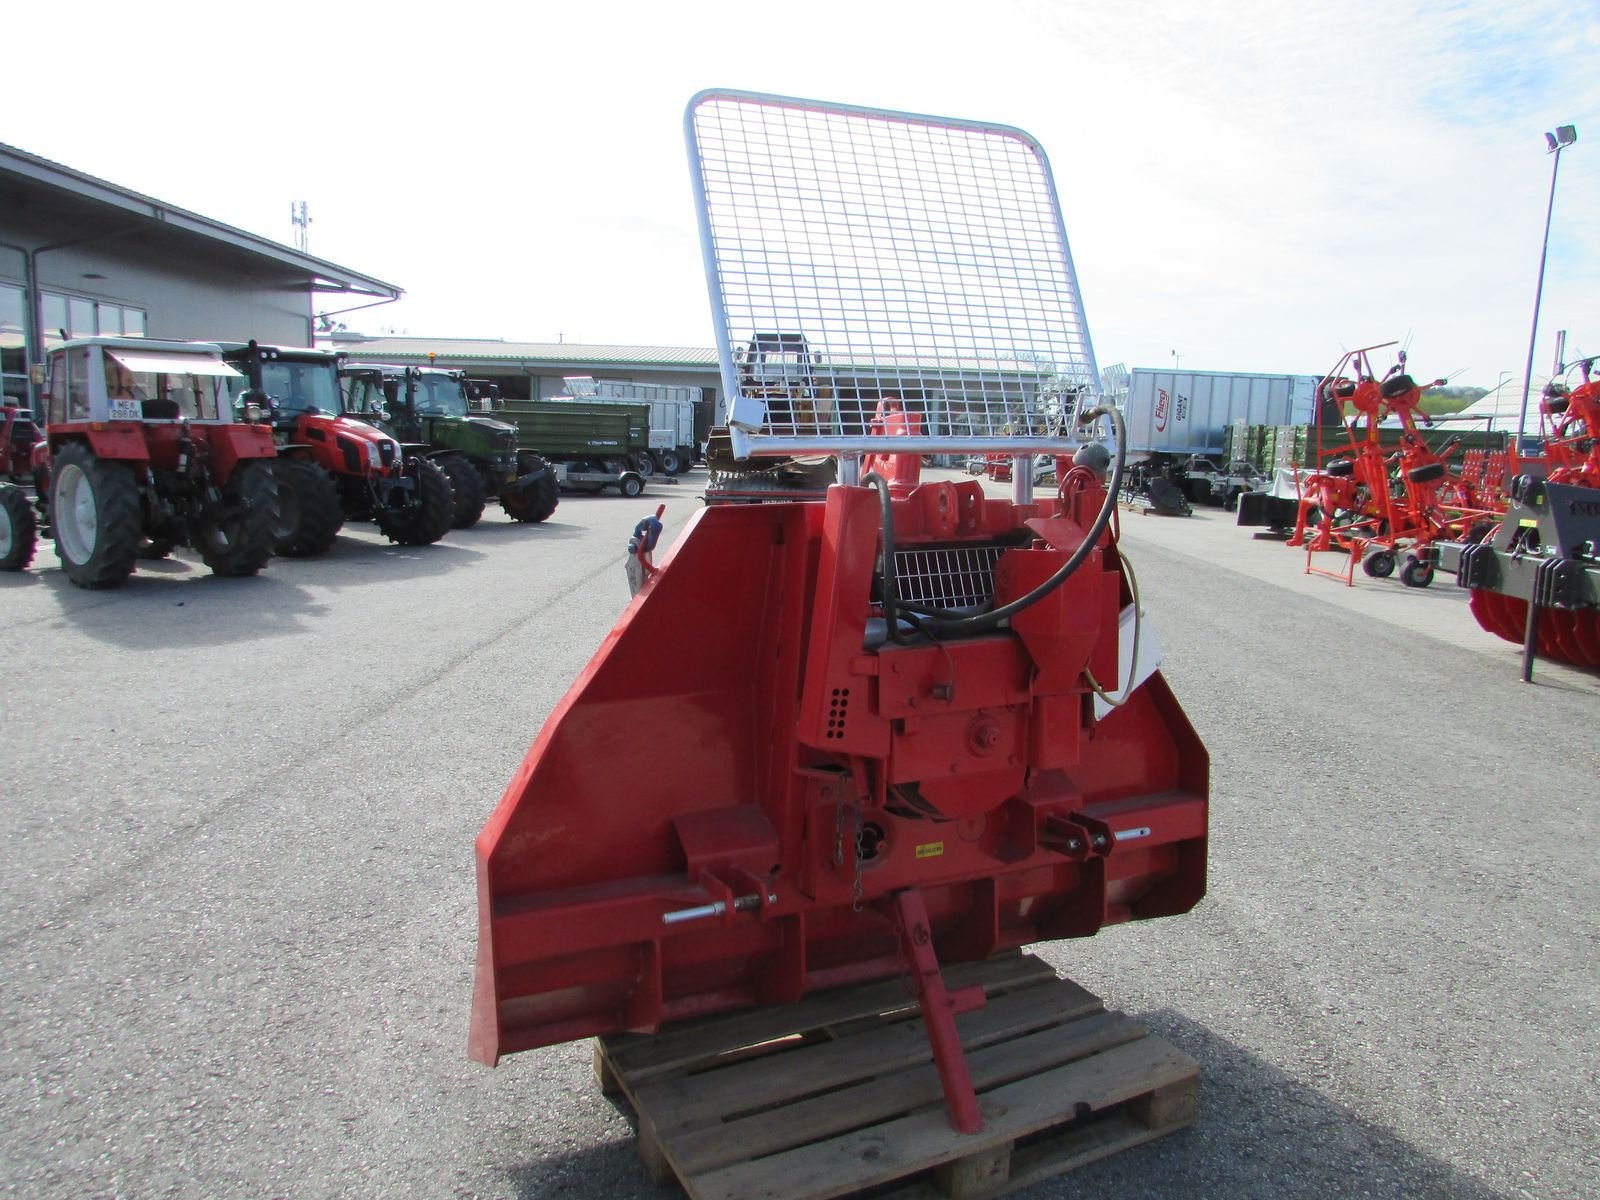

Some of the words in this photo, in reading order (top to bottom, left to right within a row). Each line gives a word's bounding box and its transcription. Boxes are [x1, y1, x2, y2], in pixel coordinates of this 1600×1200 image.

[118, 401, 129, 410] ME
[1155, 388, 1168, 419] Fliegl
[1176, 394, 1184, 421] GIGANT
